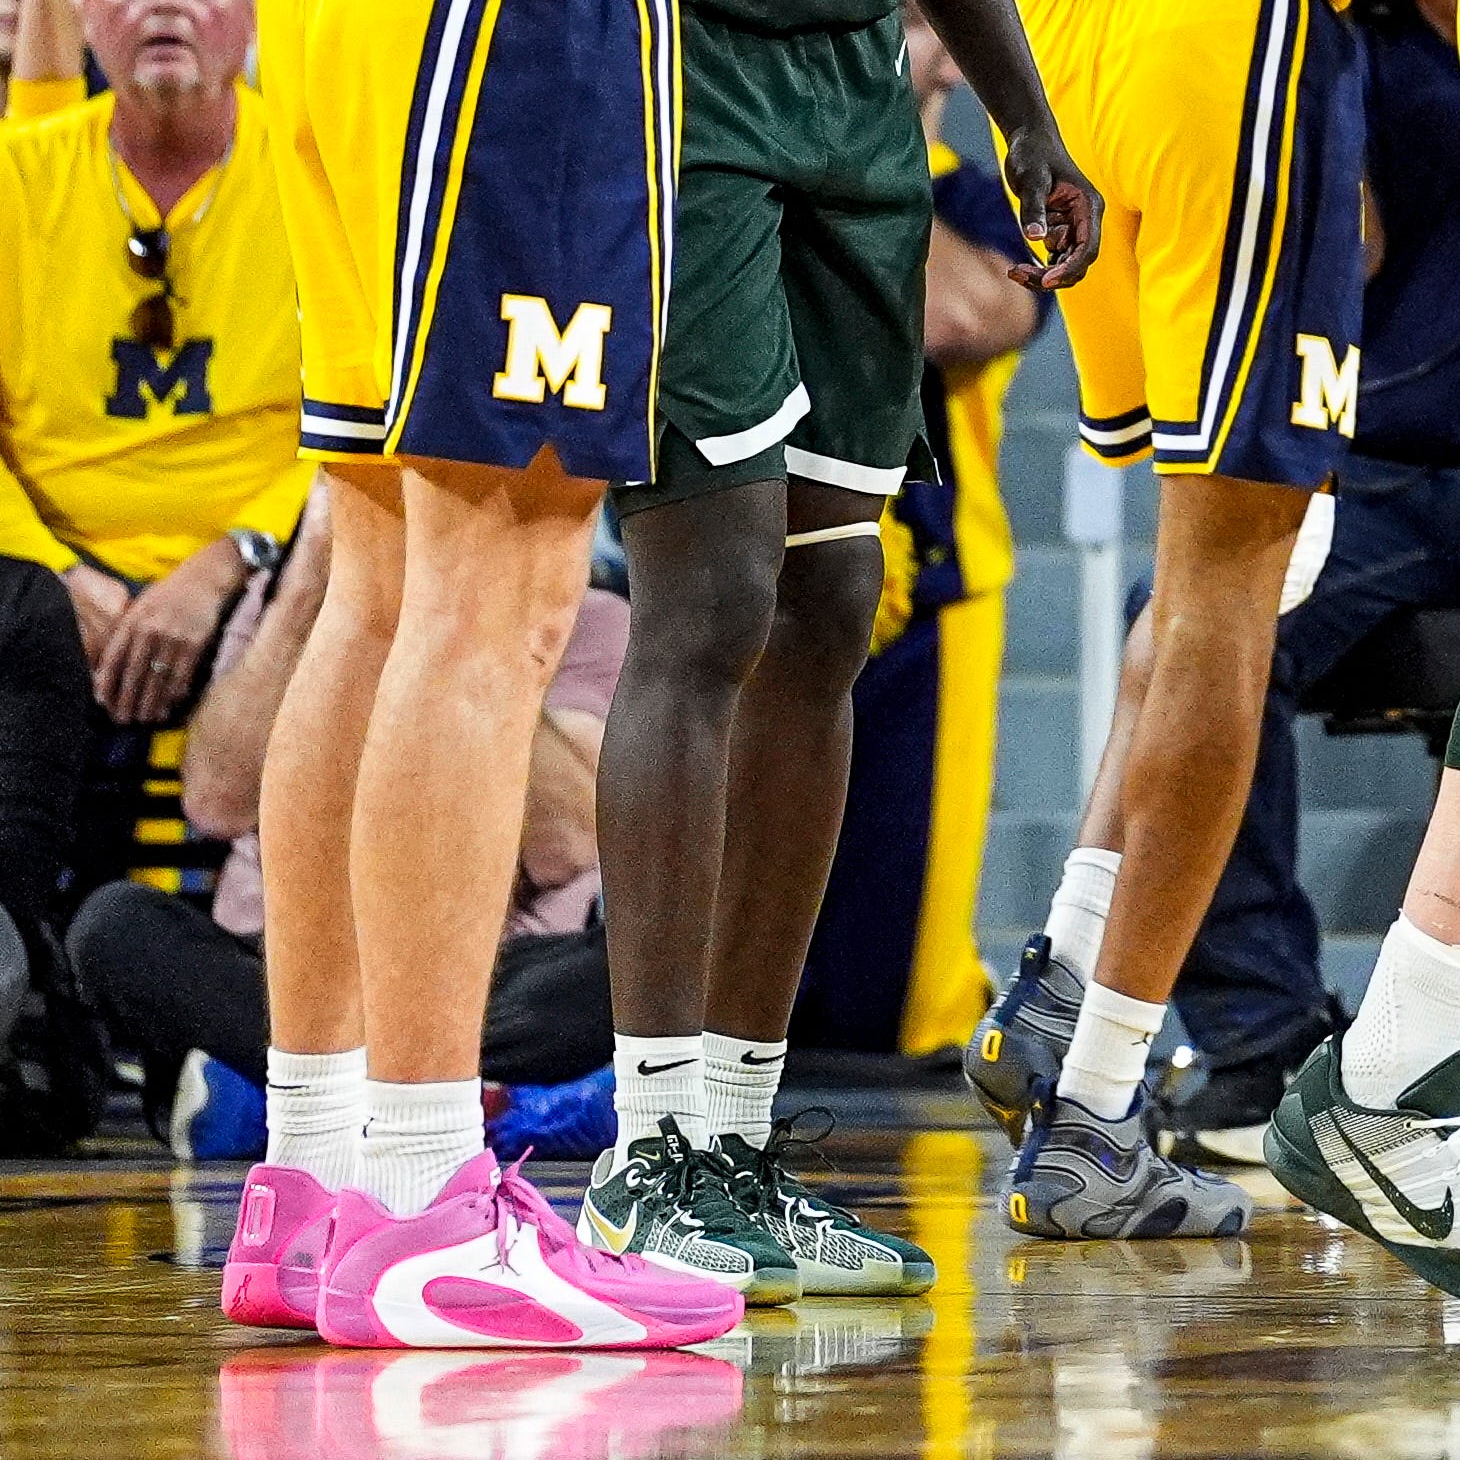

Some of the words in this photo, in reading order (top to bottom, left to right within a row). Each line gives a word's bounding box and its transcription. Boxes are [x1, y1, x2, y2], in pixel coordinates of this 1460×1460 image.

[105, 338, 214, 419] M
[492, 293, 612, 411] M
[1290, 333, 1360, 438] M
